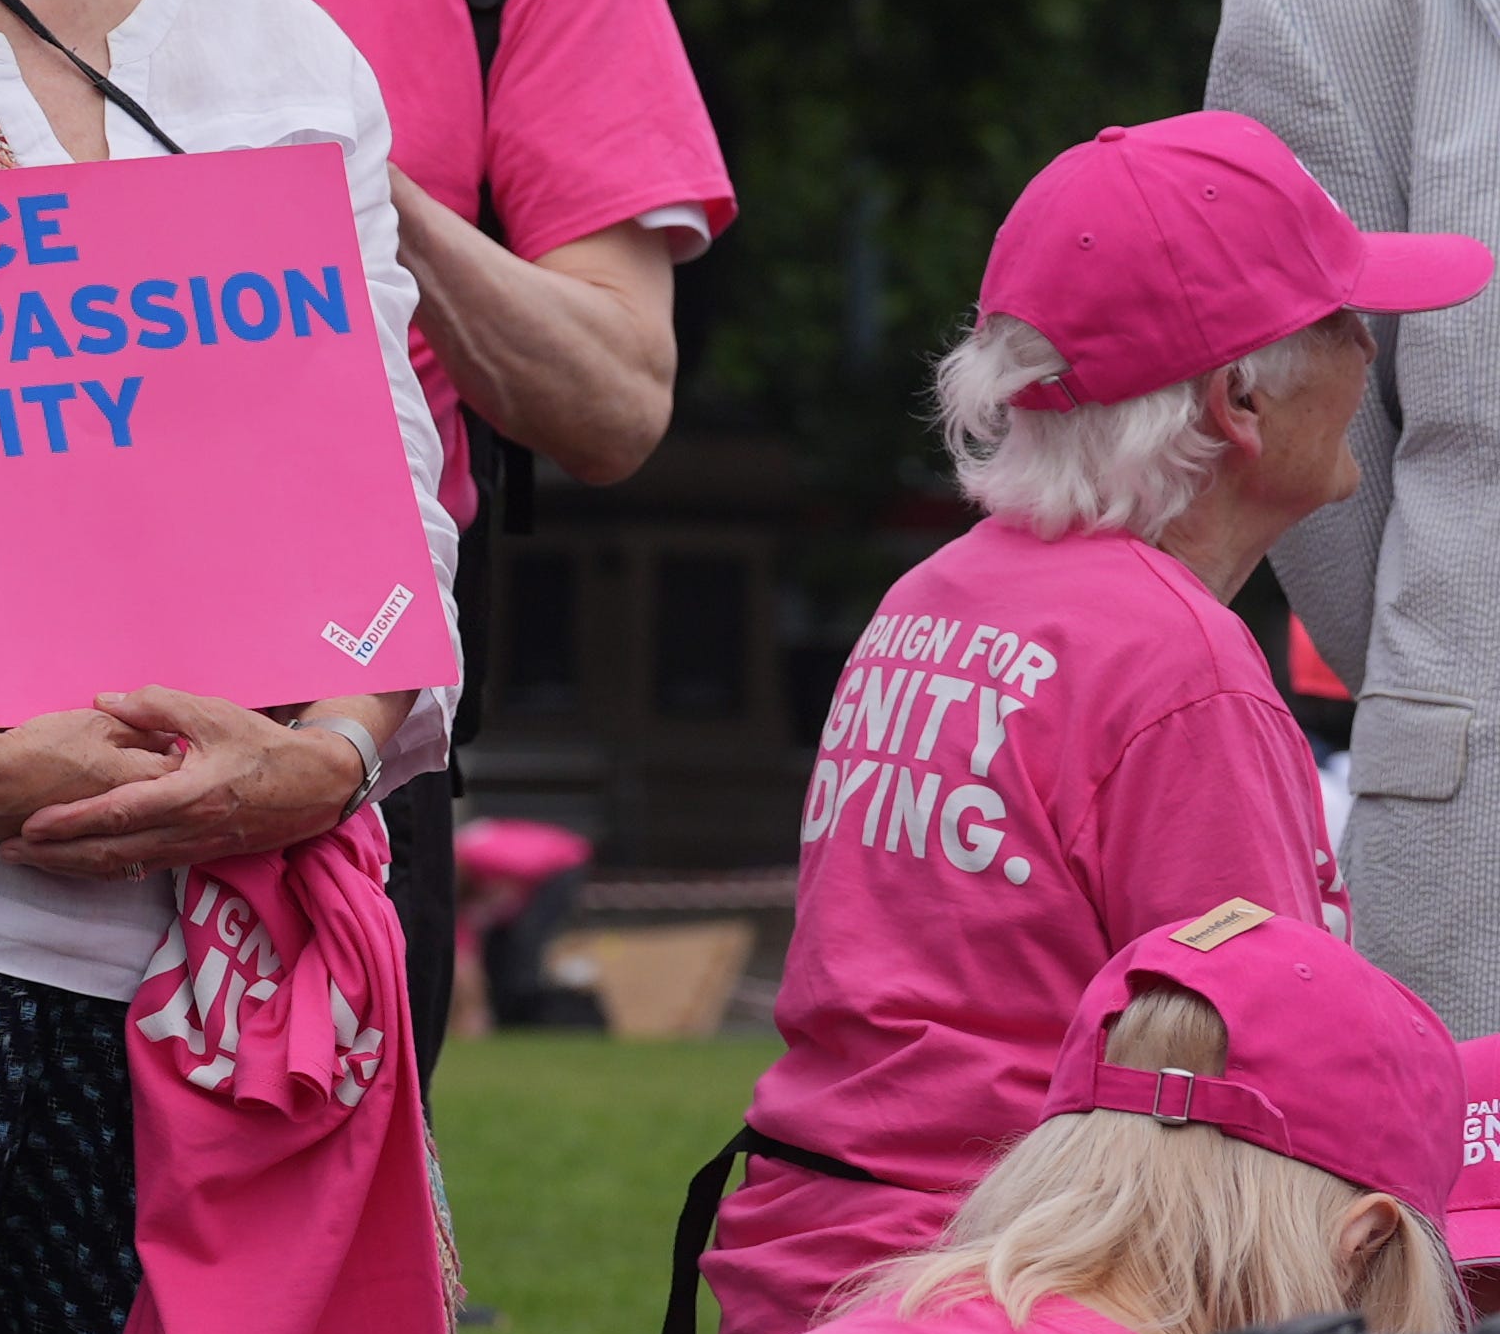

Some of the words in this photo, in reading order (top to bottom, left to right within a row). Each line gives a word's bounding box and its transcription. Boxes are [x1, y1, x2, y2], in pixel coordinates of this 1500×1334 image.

[328, 626, 357, 653] YES
[845, 614, 962, 667] PAIGN
[957, 624, 1058, 698] FOR
[822, 666, 1026, 778] GNITY
[802, 759, 1031, 885] DYING.
[1467, 1098, 1500, 1117] PAI
